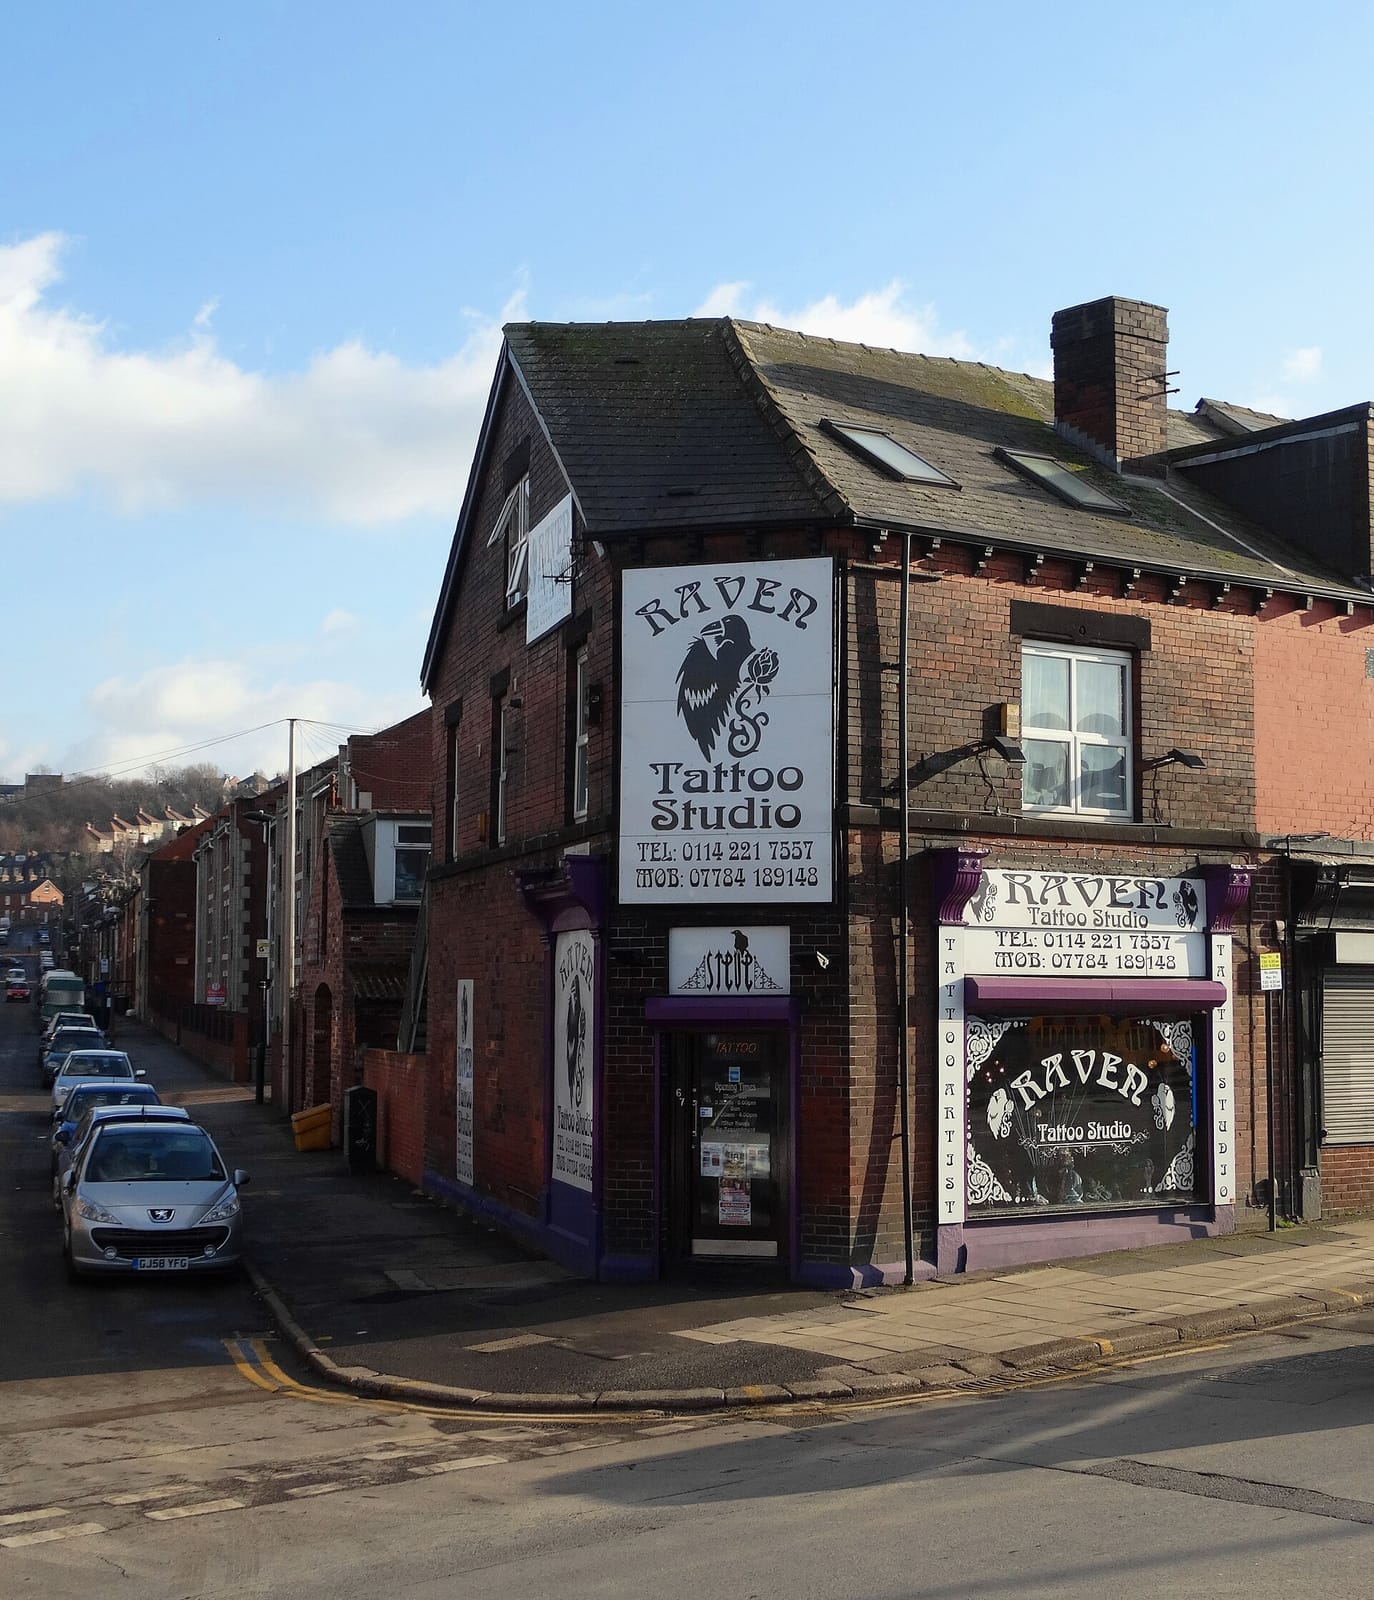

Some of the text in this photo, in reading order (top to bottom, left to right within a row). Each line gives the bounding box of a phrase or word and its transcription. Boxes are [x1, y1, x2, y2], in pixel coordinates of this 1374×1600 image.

[635, 576, 818, 637] RAVEN
[649, 761, 804, 794] Tattoo
[651, 797, 802, 831] Studio
[637, 841, 814, 863] TEL: 0114 221 7557
[636, 867, 818, 888] MOB: 07784 189148
[1001, 872, 1169, 910] RAVEN
[1027, 906, 1149, 929] Tattoo Studio
[995, 930, 1171, 950] TEL: 0114 221 7557
[995, 951, 1176, 970] MOB: 07784 189148
[945, 938, 956, 1214] TATTOO ARTIST
[1010, 1050, 1148, 1111] RAVEN
[1216, 944, 1228, 1198] TATOO STUDIO
[1037, 1120, 1132, 1142] Tattoo Studio
[139, 1258, 186, 1269] GJ58 YFG
